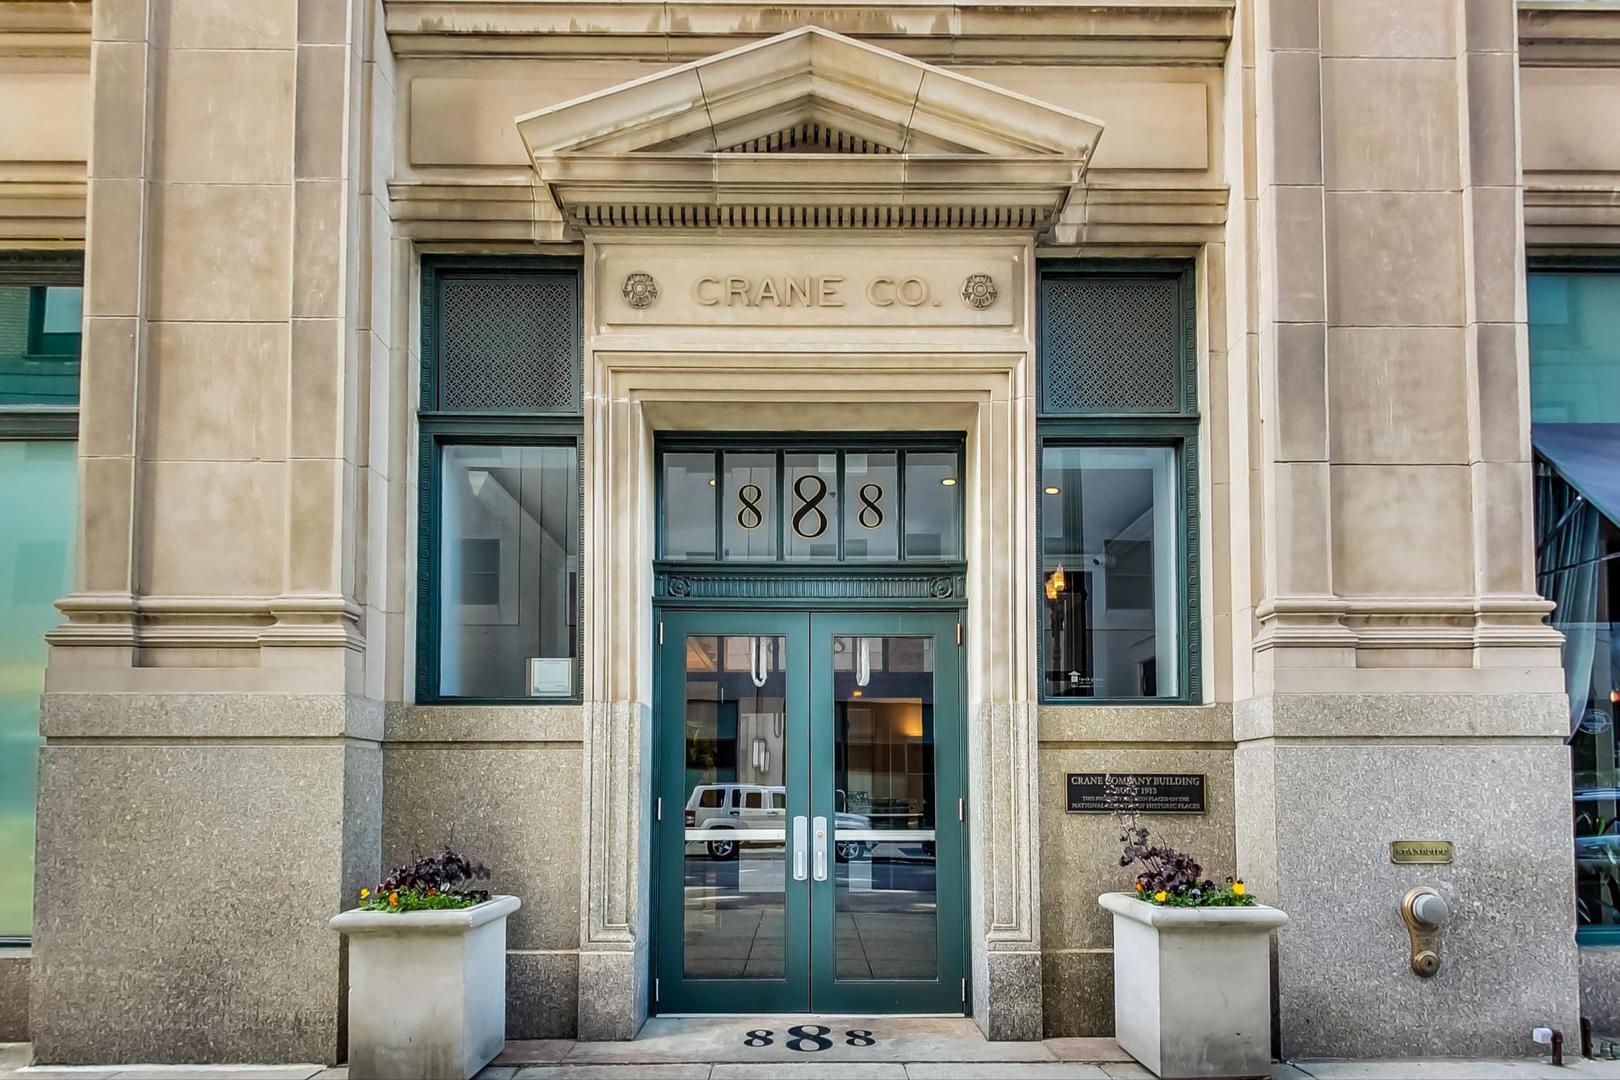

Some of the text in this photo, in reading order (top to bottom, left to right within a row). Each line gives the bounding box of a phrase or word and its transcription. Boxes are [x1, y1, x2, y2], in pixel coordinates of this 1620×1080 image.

[694, 274, 943, 308] CRANE CO.
[1071, 776, 1104, 785] CRANE
[1153, 776, 1200, 786] BUILDING
